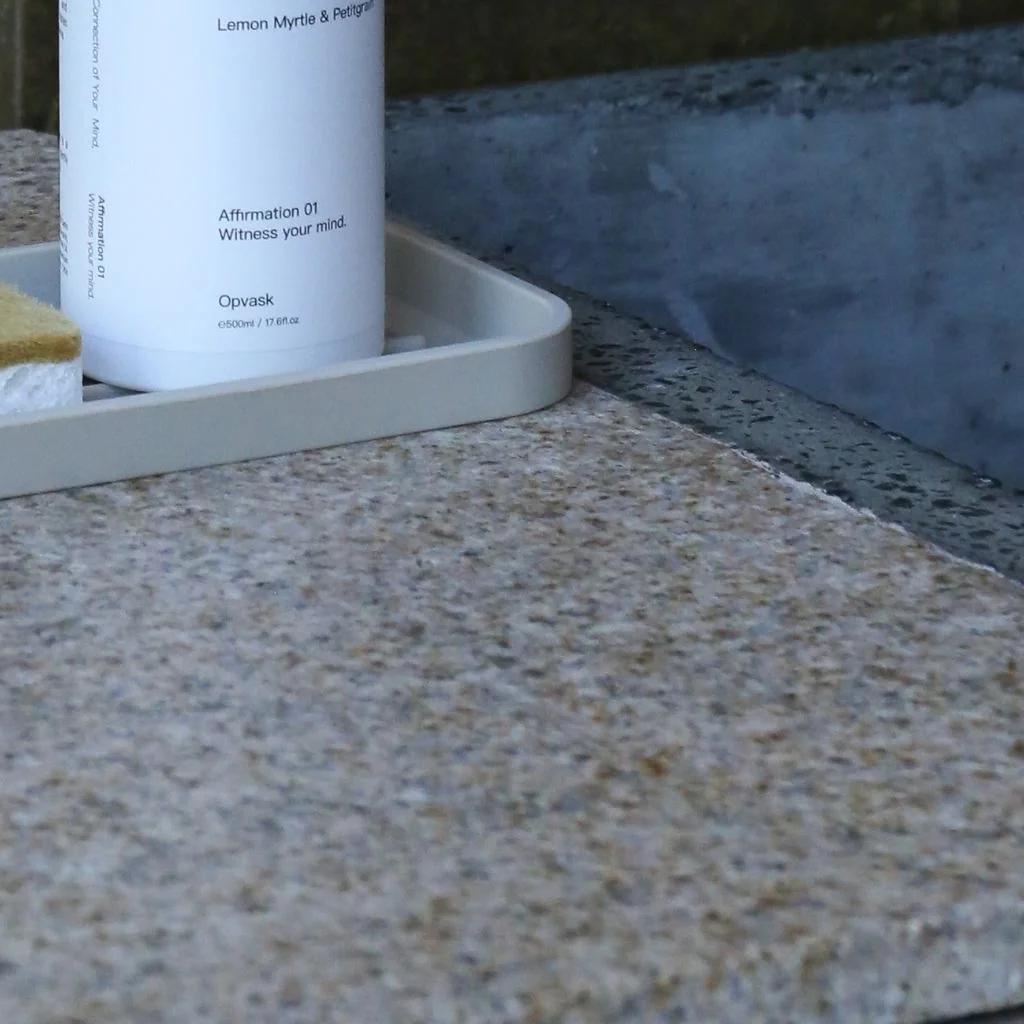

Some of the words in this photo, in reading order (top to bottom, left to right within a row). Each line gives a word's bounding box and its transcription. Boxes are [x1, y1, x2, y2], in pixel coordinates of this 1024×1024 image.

[217, 18, 268, 32] Lemon
[273, 12, 316, 31] Myrtle
[320, 9, 329, 23] &
[93, 67, 100, 80] of
[92, 84, 100, 112] Your
[88, 193, 96, 238] Witness
[218, 205, 300, 222] Affirmation
[304, 201, 318, 216] 01
[96, 194, 105, 262] Affirmation
[218, 227, 279, 241] Witness
[282, 223, 313, 241] your
[316, 215, 347, 233] mind.
[87, 242, 95, 267] your
[97, 265, 105, 279] 01
[218, 293, 275, 310] Opvask
[257, 317, 263, 328] /
